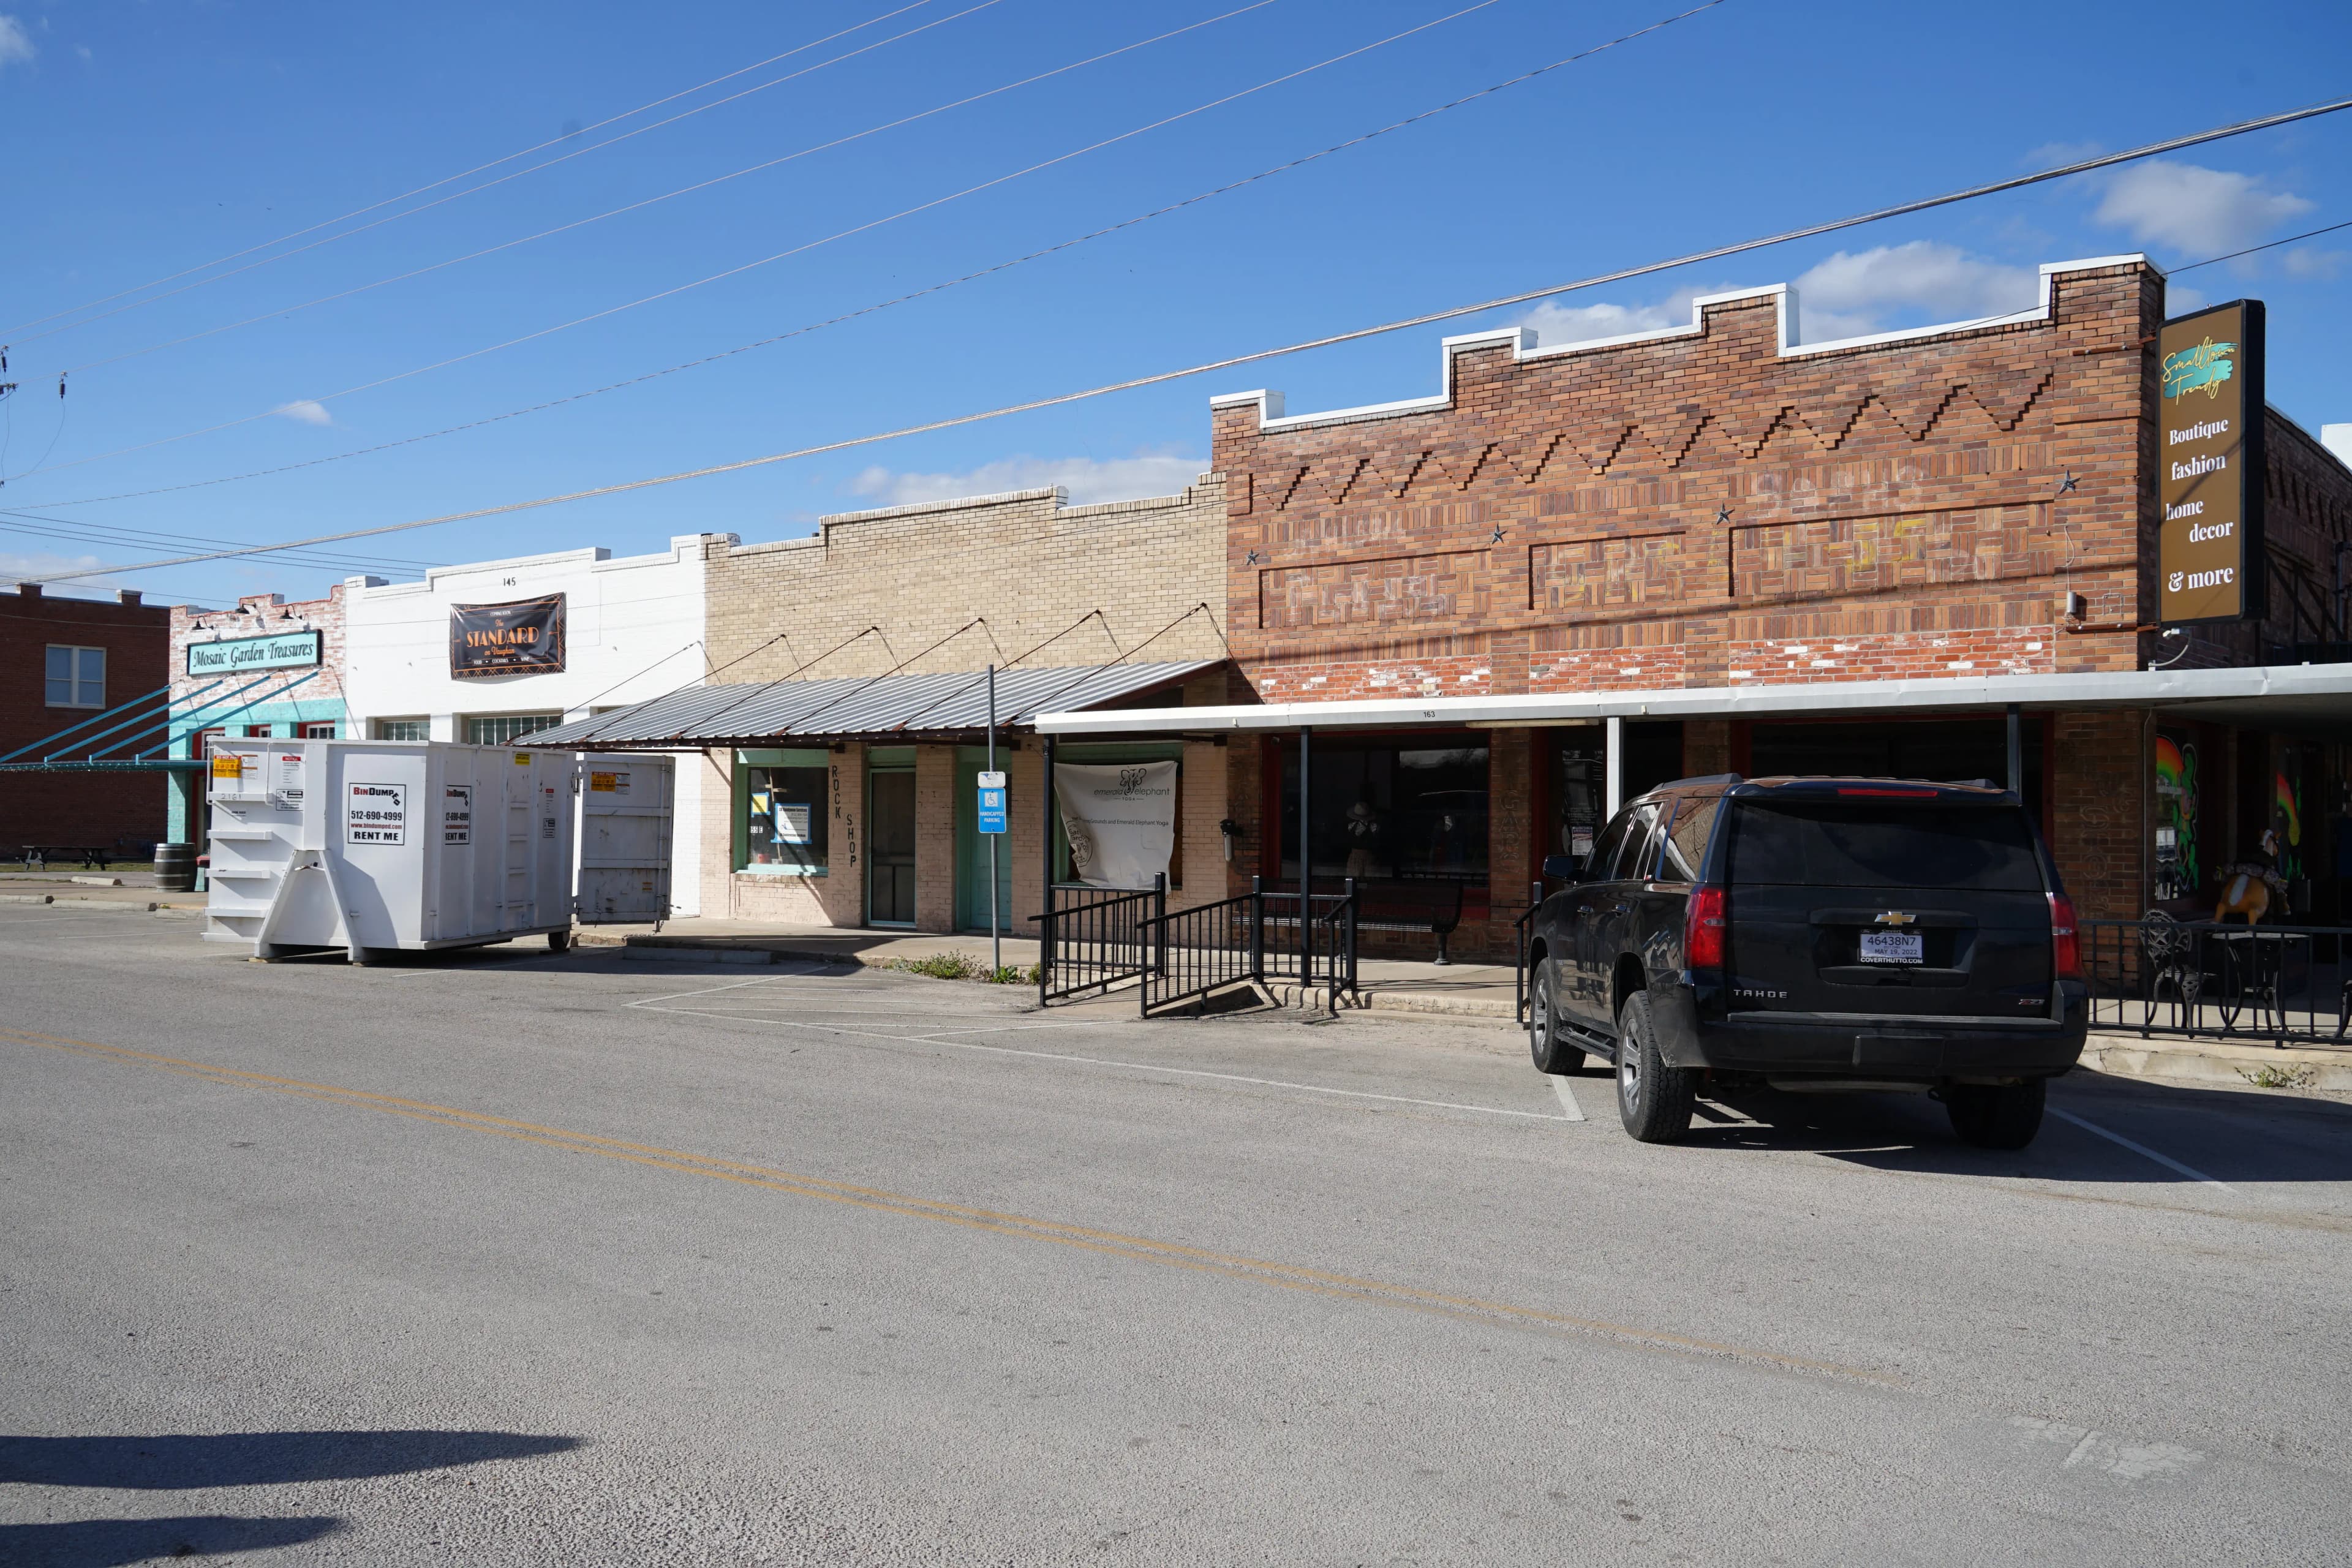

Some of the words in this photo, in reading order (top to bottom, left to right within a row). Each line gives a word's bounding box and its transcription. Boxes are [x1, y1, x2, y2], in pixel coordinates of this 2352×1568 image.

[2171, 368, 2224, 405] Trendy
[2169, 419, 2228, 445] Boutique
[2171, 454, 2226, 481] fashion
[2166, 500, 2204, 521] home
[2189, 521, 2234, 543] decor
[503, 577, 516, 586] 145
[2168, 571, 2184, 592] &
[2187, 567, 2234, 589] more
[467, 627, 539, 647] STANDARD
[193, 648, 227, 668] Mosaic
[230, 643, 264, 668] Garden
[268, 641, 314, 660] Treasures
[832, 766, 841, 819] ROCK
[1134, 786, 1170, 796] elephant
[351, 810, 402, 821] 512-690-4999
[354, 831, 381, 840] RENT
[383, 832, 399, 841] ME
[847, 814, 856, 868] SHOP
[1868, 936, 1916, 946] 46438N7
[1733, 989, 1787, 998] TAHOE
